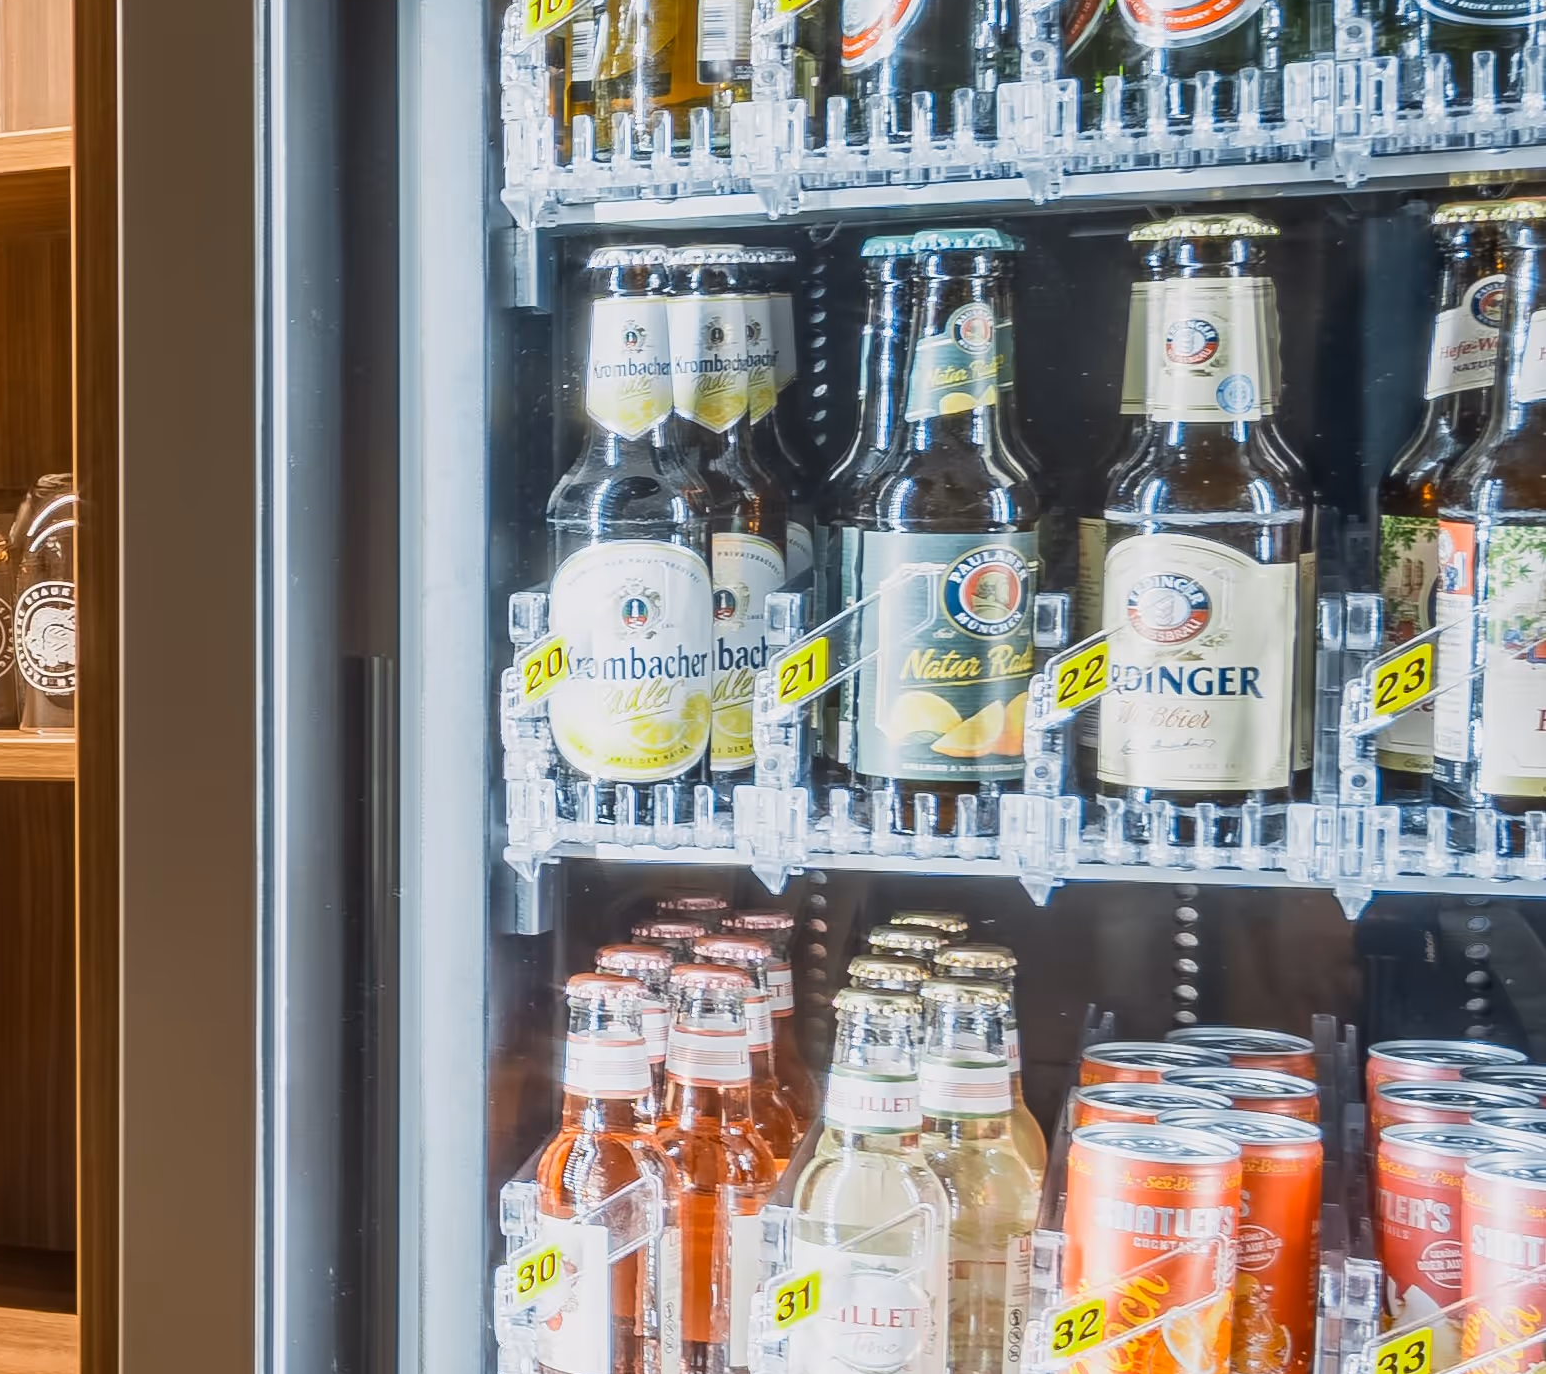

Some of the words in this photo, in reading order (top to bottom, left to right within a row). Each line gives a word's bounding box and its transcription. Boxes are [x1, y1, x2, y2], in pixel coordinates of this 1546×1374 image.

[947, 549, 1029, 583] PAULANER
[25, 586, 73, 608] BRAUK
[525, 646, 563, 696] 20
[566, 644, 708, 683] Krombacher
[780, 653, 815, 699] 21
[899, 647, 983, 681] Natur
[987, 641, 1035, 674] Rad
[1058, 654, 1105, 704] 22
[1375, 657, 1426, 710] 23
[1379, 1189, 1454, 1235] TLER'S
[519, 1250, 559, 1295] 30
[778, 1280, 811, 1322] 31
[827, 1306, 920, 1330] ILLET
[1053, 1308, 1100, 1351] 32
